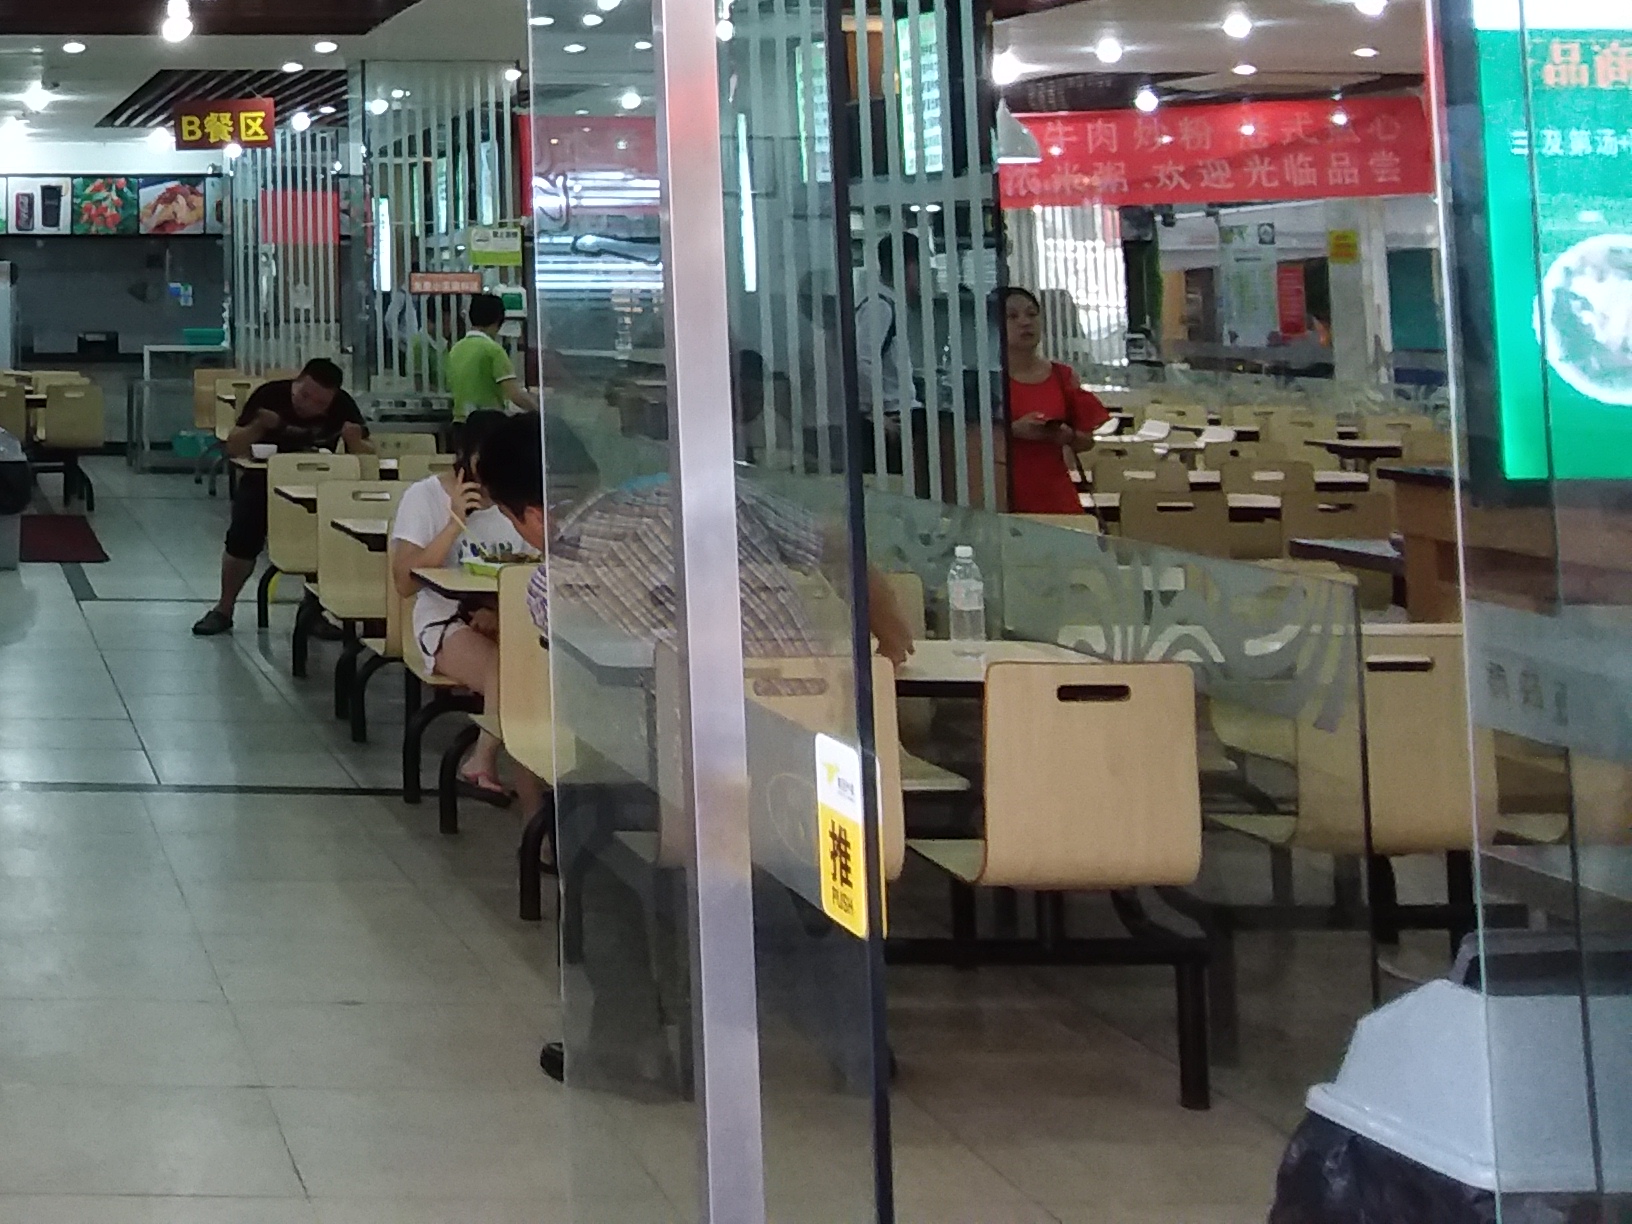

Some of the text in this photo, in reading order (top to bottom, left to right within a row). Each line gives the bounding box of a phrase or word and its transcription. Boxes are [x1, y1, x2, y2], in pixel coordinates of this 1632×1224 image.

[181, 111, 269, 143] B餐区
[829, 819, 853, 889] 推
[831, 885, 854, 915] PUSH
